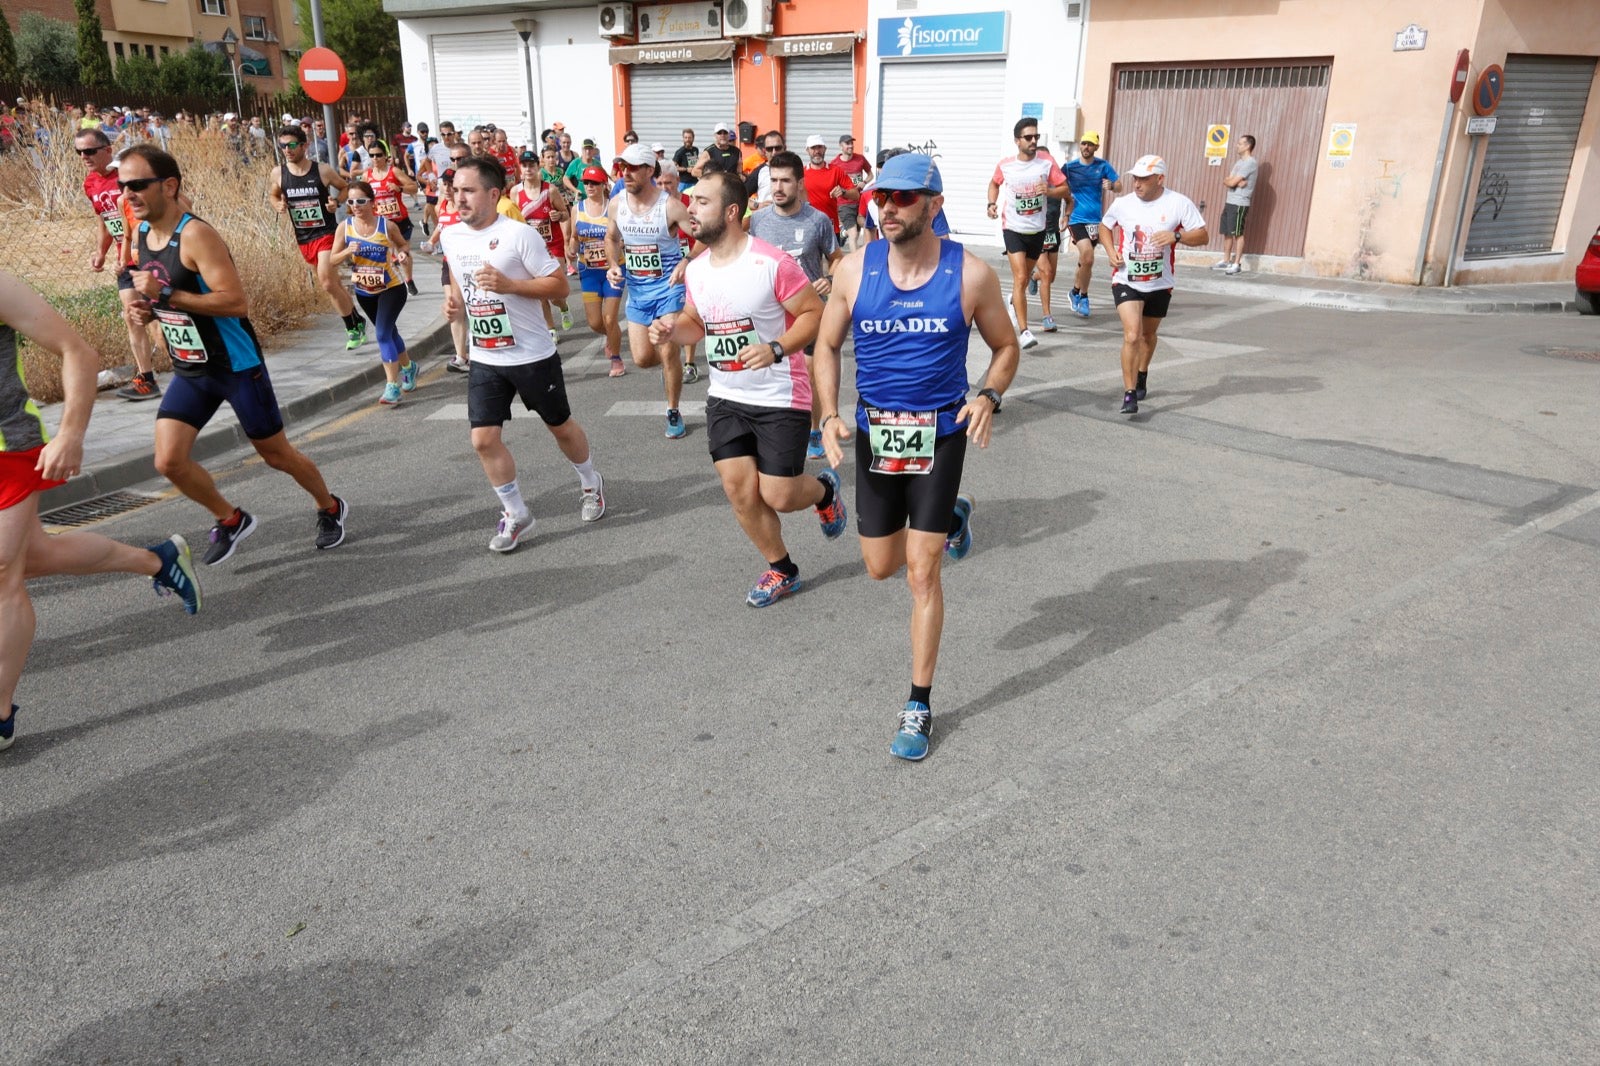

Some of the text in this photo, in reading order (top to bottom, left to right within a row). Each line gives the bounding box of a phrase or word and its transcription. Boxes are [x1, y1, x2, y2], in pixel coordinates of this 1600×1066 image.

[912, 25, 983, 48] fisiomar
[784, 41, 832, 52] Estetica
[286, 187, 319, 195] GRANADA
[1020, 198, 1039, 209] 354
[296, 209, 318, 219] 212
[622, 225, 660, 234] MARACENA
[628, 255, 660, 268] 1056
[1134, 262, 1158, 273] 355
[356, 275, 382, 285] 2198
[473, 318, 503, 335] 409
[860, 318, 949, 334] GUADIX
[164, 326, 194, 345] 234
[714, 335, 750, 356] 408
[881, 429, 923, 453] 254
